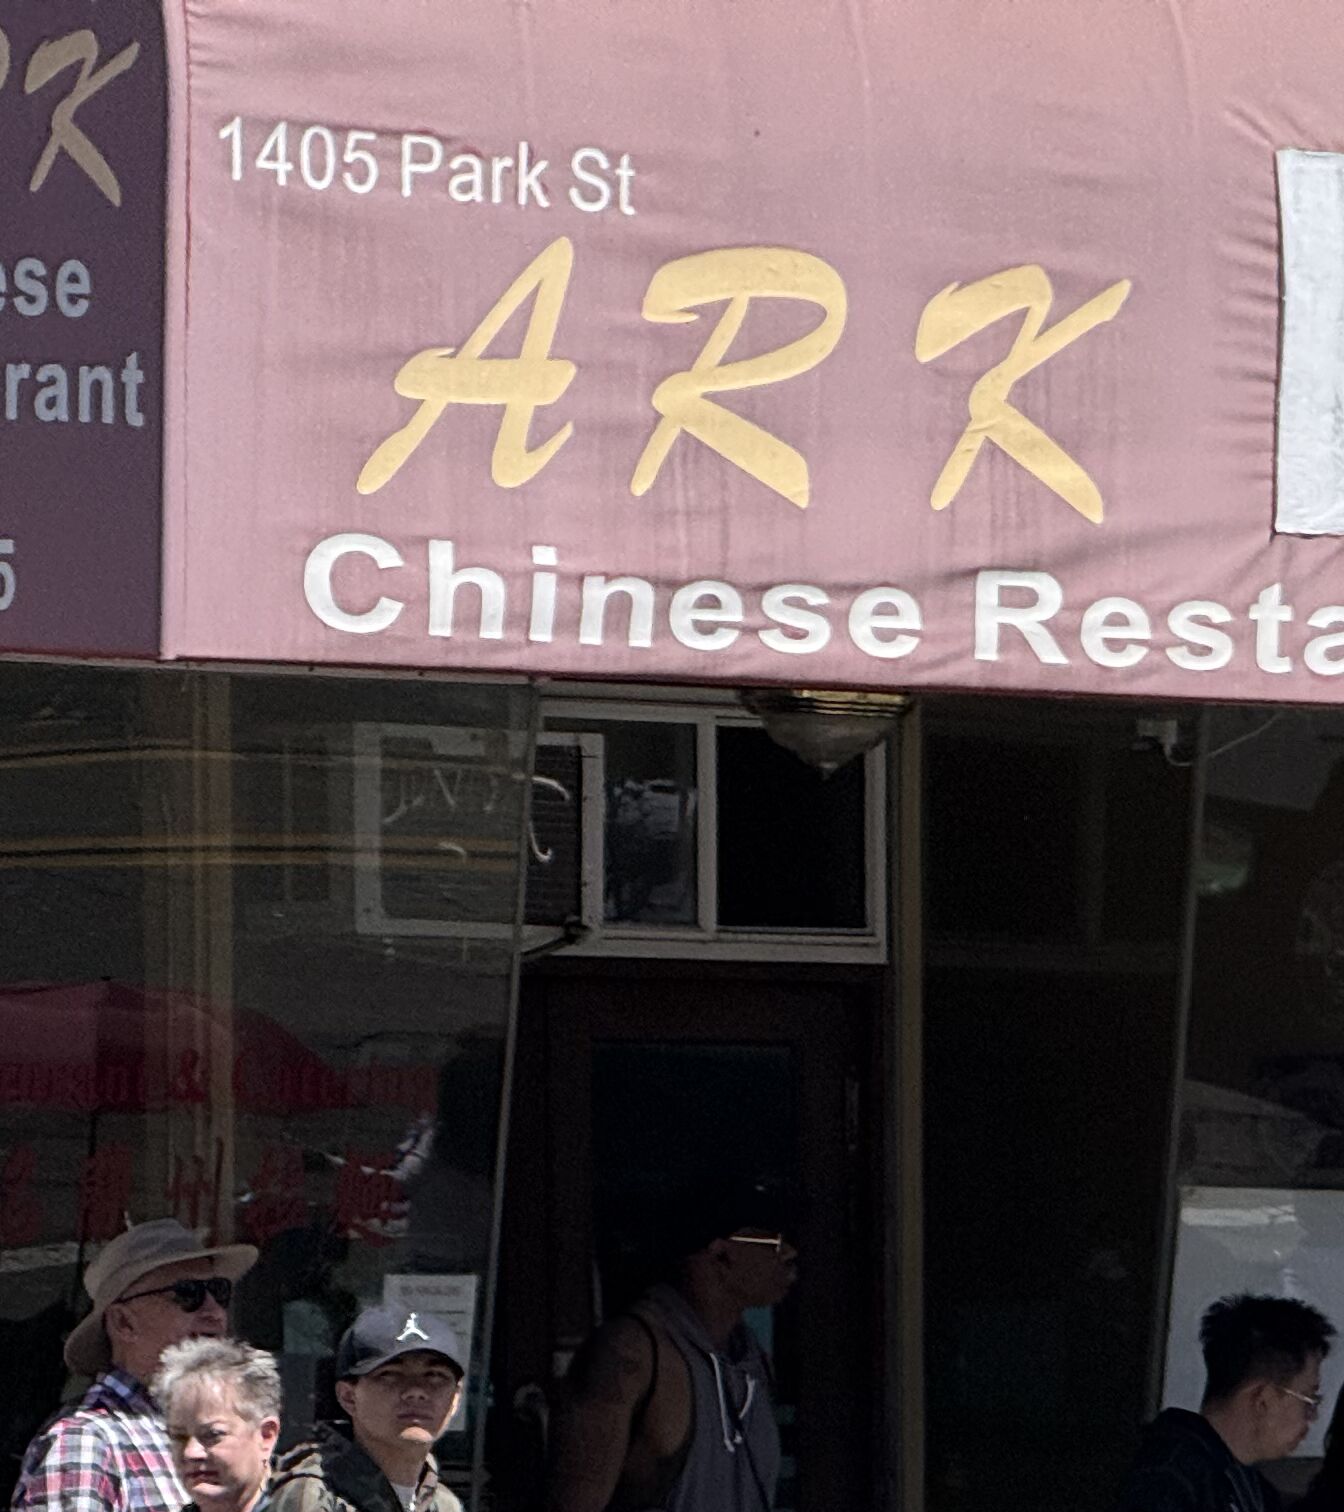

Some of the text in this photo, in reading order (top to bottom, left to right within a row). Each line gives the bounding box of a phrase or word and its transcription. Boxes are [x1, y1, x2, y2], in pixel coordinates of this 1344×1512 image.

[0, 28, 140, 207] K
[218, 116, 637, 217] 1405 Park St
[0, 255, 92, 319] se
[356, 236, 1133, 524] ARK
[303, 532, 924, 658] Chinese
